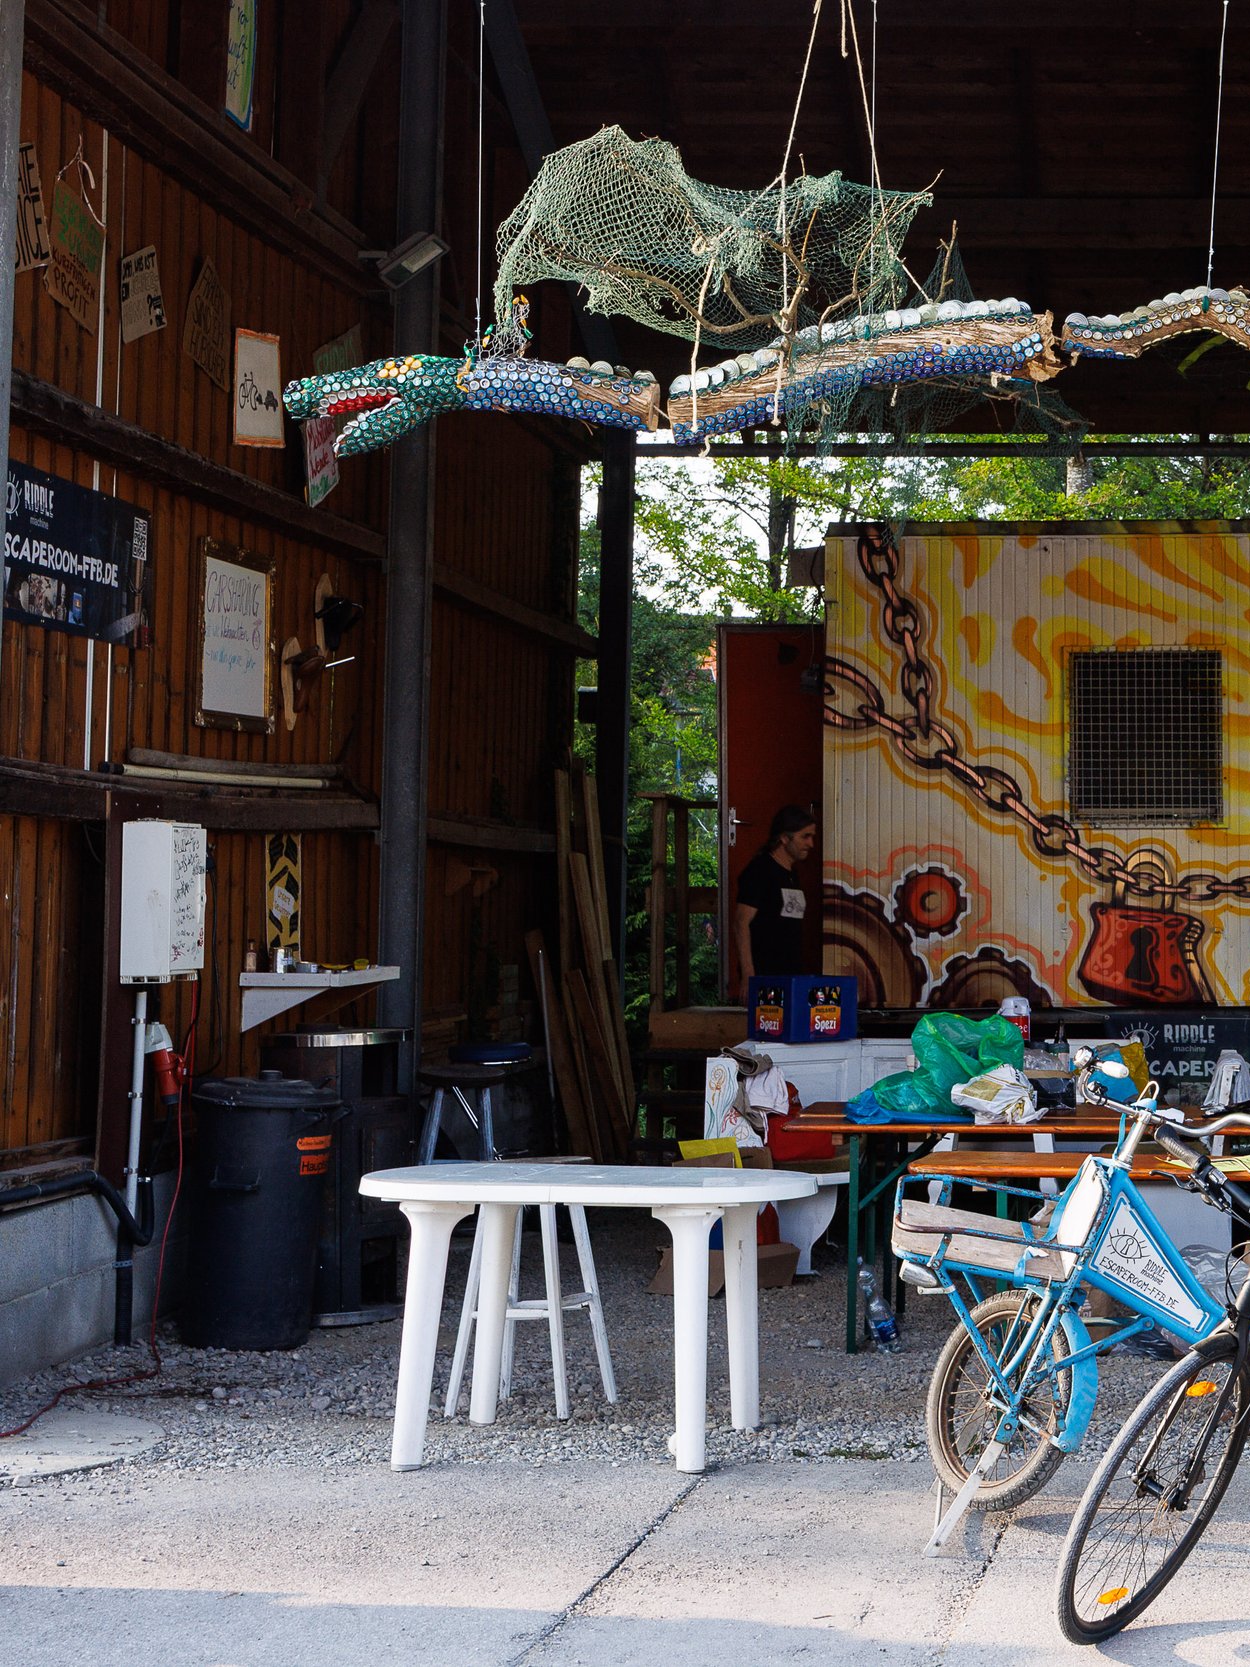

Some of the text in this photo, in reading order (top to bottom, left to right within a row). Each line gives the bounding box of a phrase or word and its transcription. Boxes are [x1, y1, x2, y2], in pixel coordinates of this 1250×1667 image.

[54, 266, 89, 318] PROFIT
[24, 480, 54, 518] RIDDLE
[4, 532, 118, 587] SCAPEROOM-FFB.DE
[759, 1015, 780, 1032] Spezi
[814, 1015, 837, 1032] Spezi
[1164, 1024, 1215, 1044] RIDDLE
[1173, 1045, 1206, 1053] machine
[1140, 1268, 1164, 1286] machine
[1144, 1258, 1169, 1280] RIDDLE
[1099, 1256, 1180, 1310] ESCAPEROOM-FFB.DE
